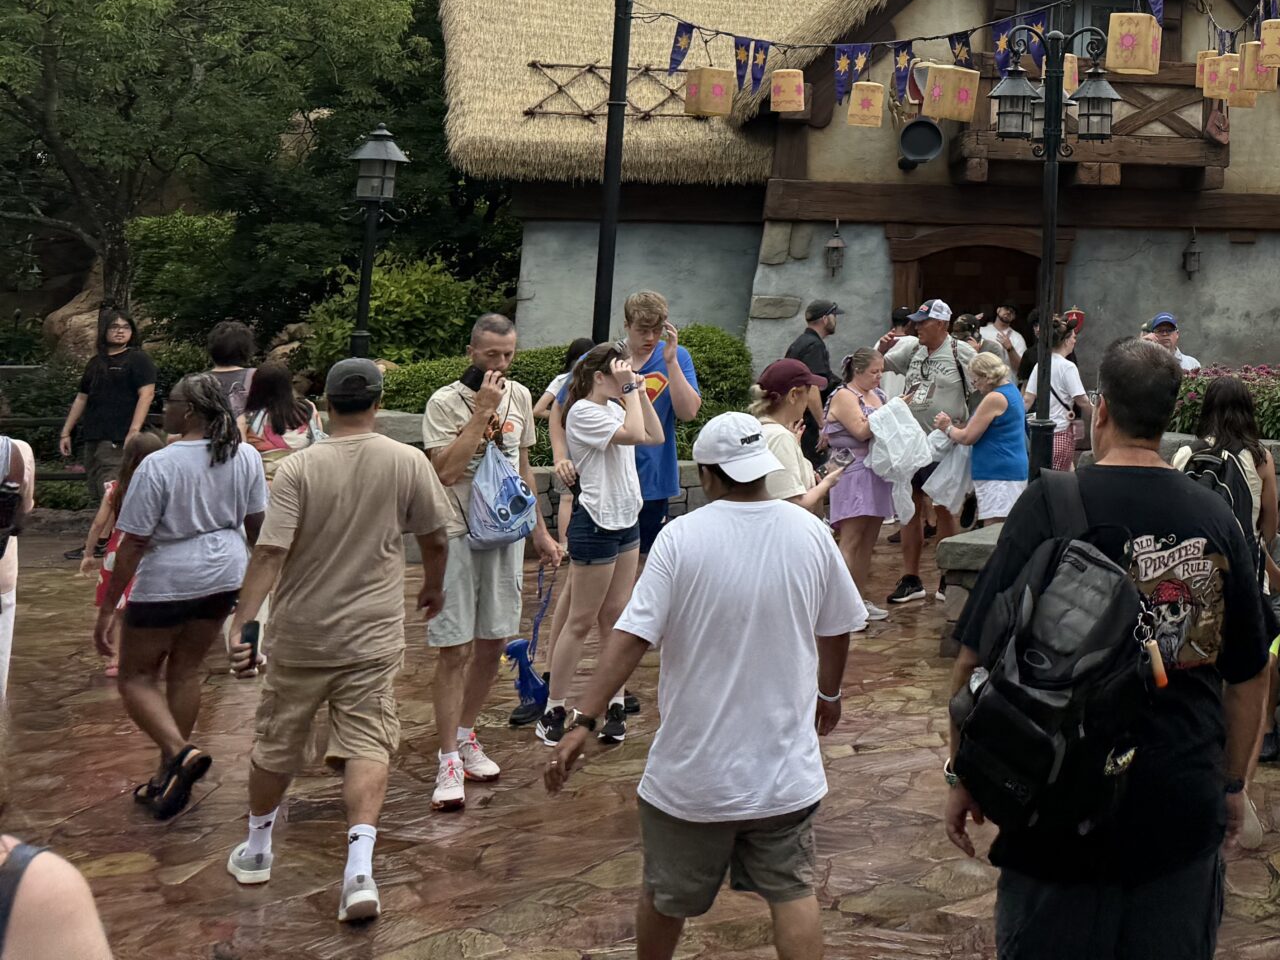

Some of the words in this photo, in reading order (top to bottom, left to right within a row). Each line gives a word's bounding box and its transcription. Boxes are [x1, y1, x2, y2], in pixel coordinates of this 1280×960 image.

[1132, 538, 1153, 553] OLD
[1140, 541, 1202, 578] PIRATES
[1181, 561, 1210, 578] RULE
